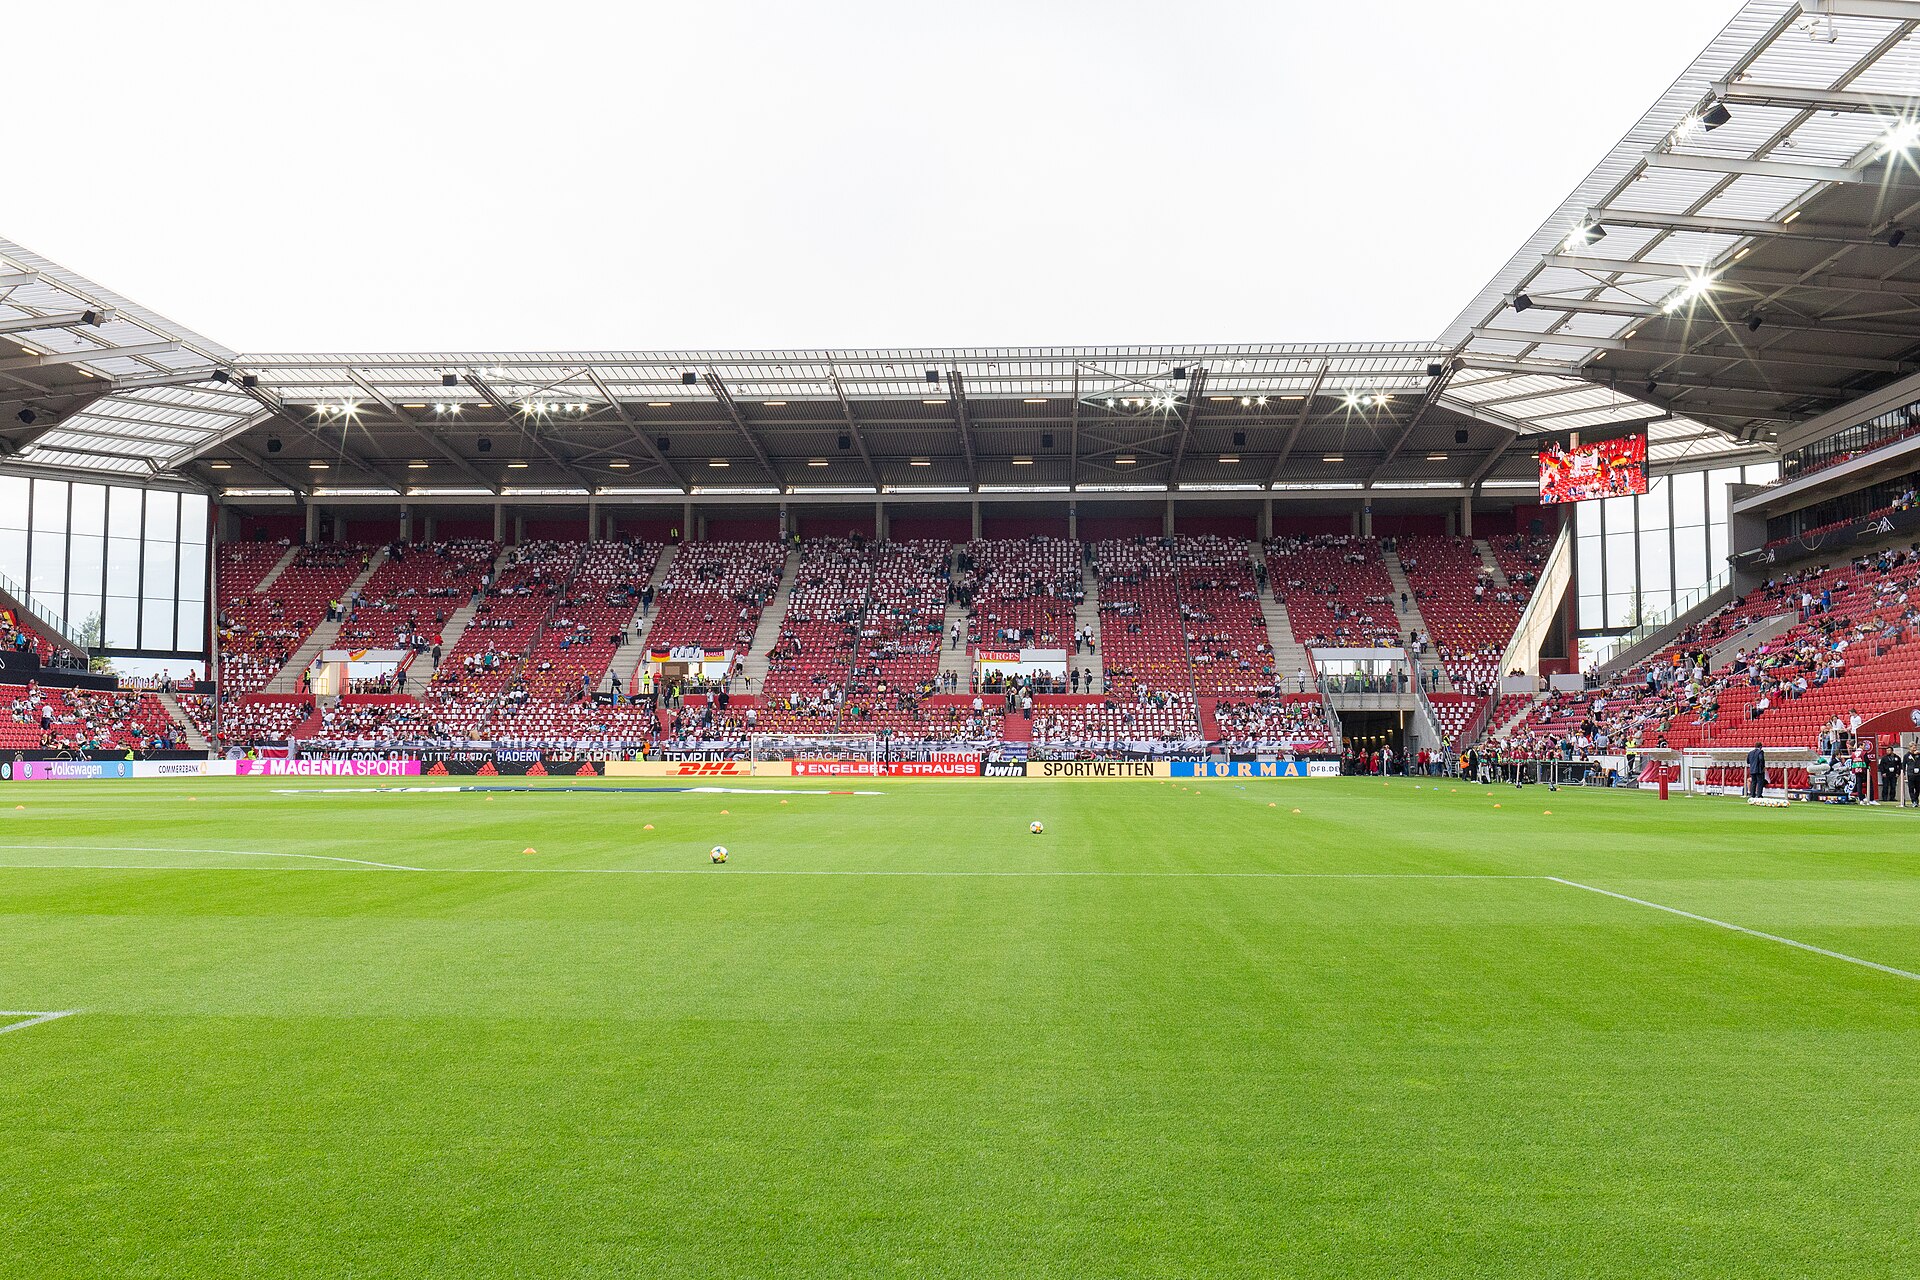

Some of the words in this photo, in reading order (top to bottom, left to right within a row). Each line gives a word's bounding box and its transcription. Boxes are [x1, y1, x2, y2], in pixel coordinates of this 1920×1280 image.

[980, 651, 1020, 660] WÜRGES
[497, 751, 540, 762] HADERN
[664, 752, 724, 762] TEMPLIN
[800, 752, 867, 761] BRACHELEN
[931, 753, 980, 762] URBACH
[50, 762, 103, 778] Volkswagen
[158, 765, 199, 774] COMMERZBANK
[270, 760, 354, 775] MAGENTA
[356, 760, 409, 775] SPORT
[677, 762, 739, 775] DHL
[808, 764, 898, 773] ENGELBERT
[902, 764, 976, 773] STRAUSS
[985, 763, 1022, 776] bwin
[1043, 762, 1154, 776] SPORTWETTEN
[1310, 765, 1340, 773] DFB.DE
